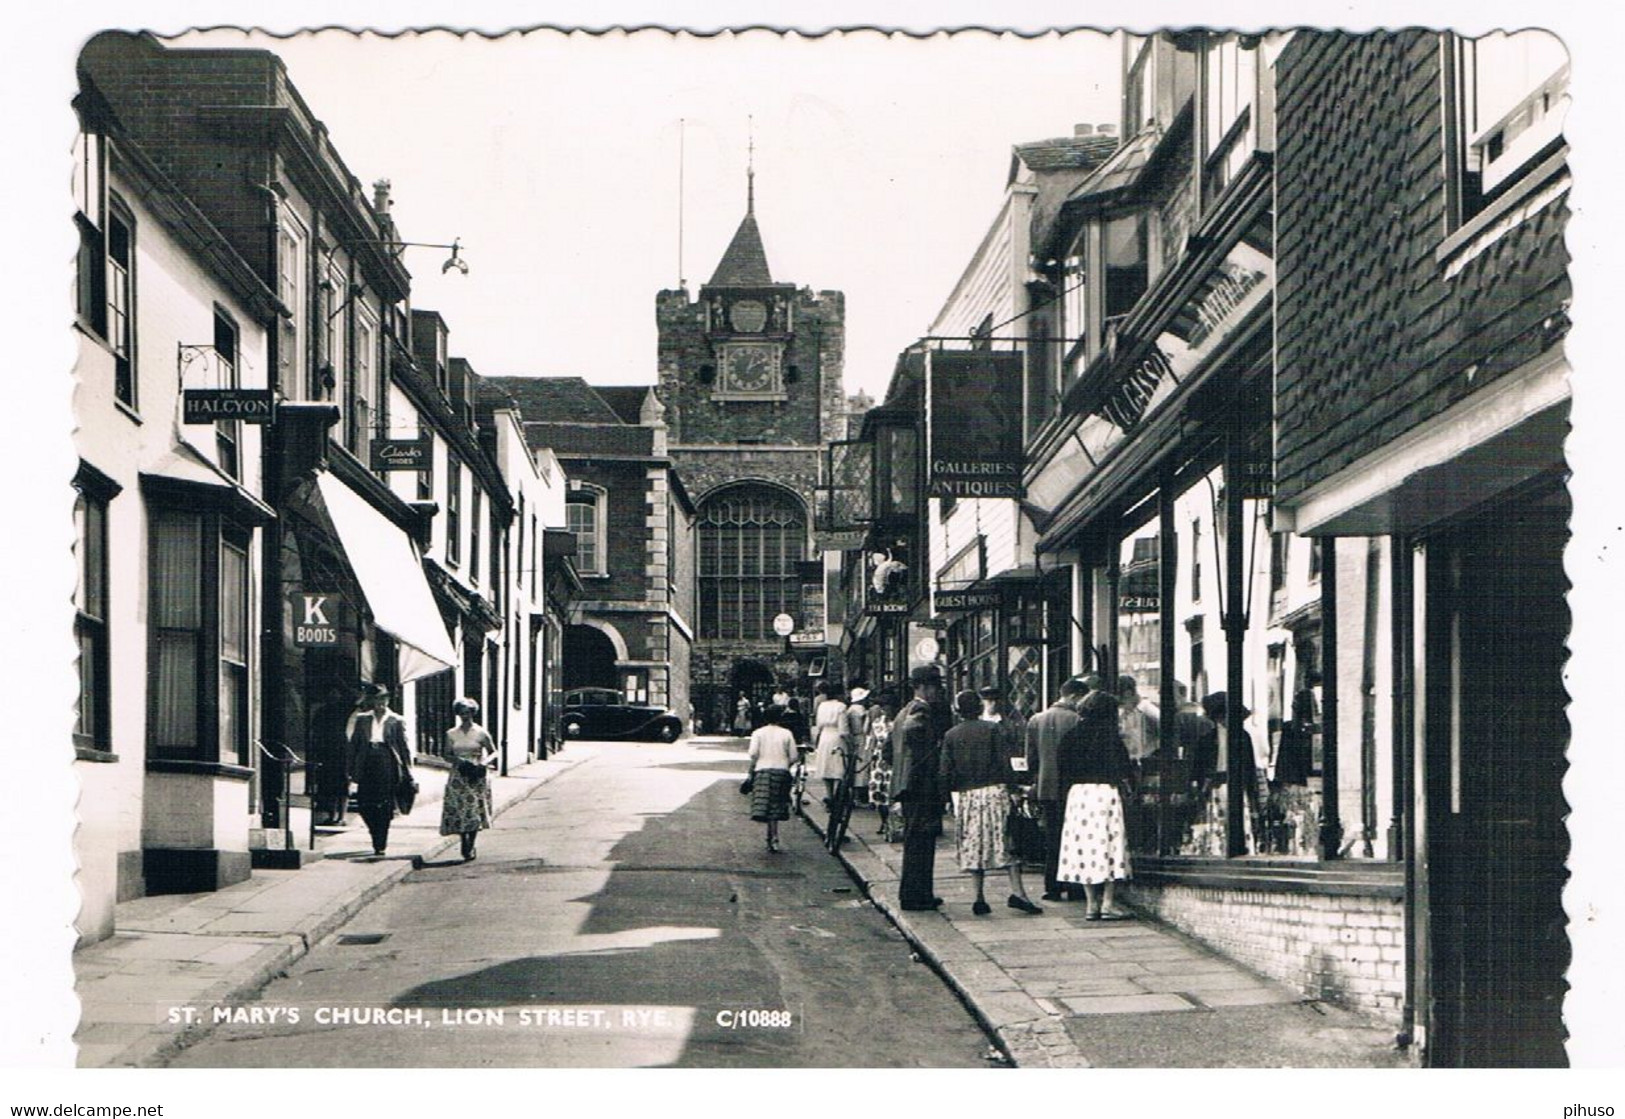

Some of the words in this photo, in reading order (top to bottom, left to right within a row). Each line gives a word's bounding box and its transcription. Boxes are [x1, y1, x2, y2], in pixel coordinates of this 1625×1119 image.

[187, 399, 270, 413] HALCYON
[379, 444, 422, 458] Clarks
[933, 460, 1017, 474] GALLERIES
[931, 480, 1017, 495] ANTIQUES
[935, 595, 967, 607] GUEST
[969, 594, 1001, 605] HOUSE
[303, 596, 330, 624] K
[297, 626, 336, 643] BOOTS
